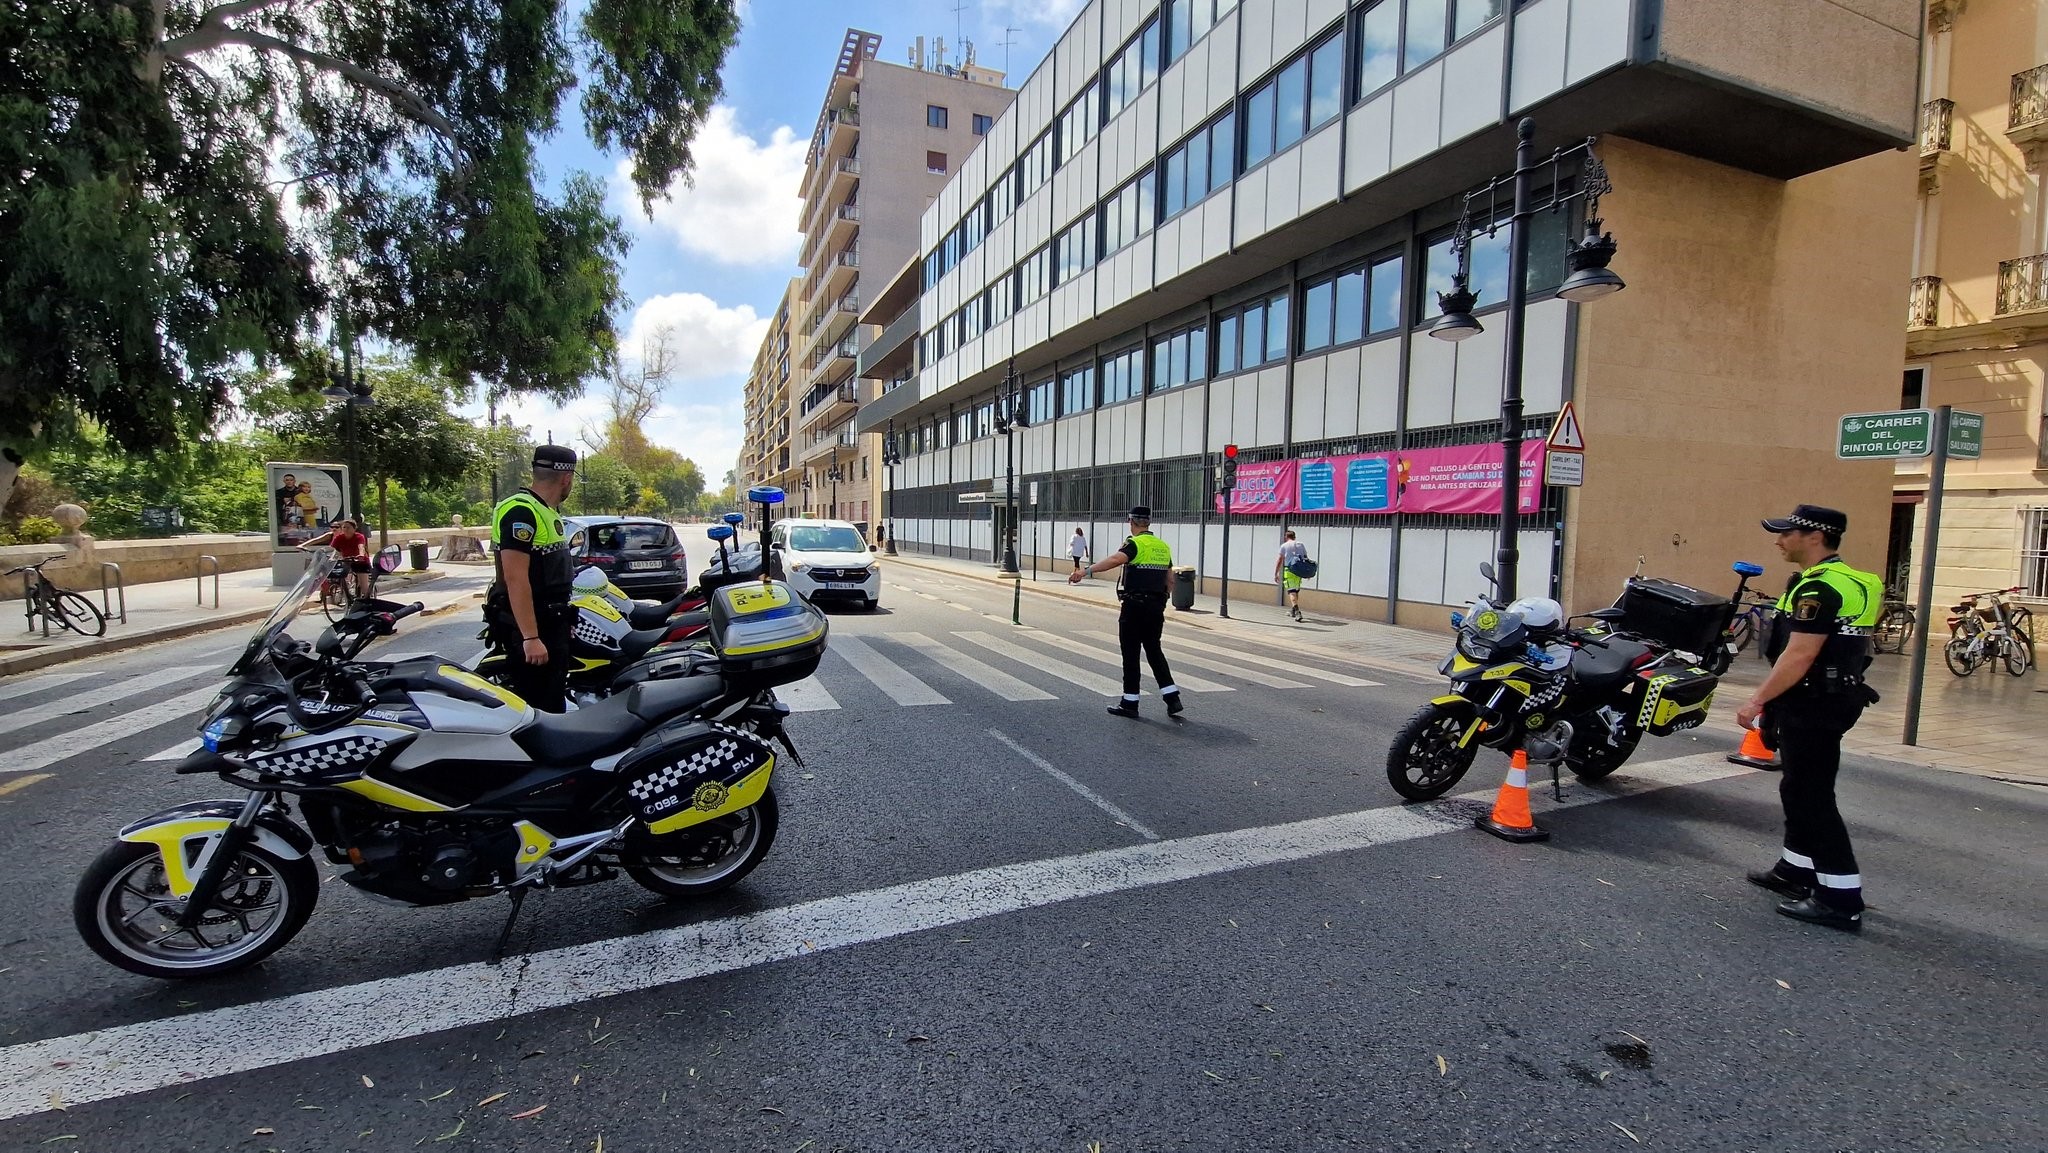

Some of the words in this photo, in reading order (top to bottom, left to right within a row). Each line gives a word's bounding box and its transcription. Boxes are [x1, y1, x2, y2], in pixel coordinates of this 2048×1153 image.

[1865, 416, 1922, 429] CARRER
[1959, 417, 1981, 428] CARRER
[1872, 431, 1894, 439] DEL
[1961, 430, 1970, 438] DEL
[1842, 442, 1883, 453] PINTOR
[1886, 438, 1924, 451] LÓPEZ
[1949, 440, 1979, 451] SALVADOR
[1429, 463, 1457, 473] INCLUSO
[1458, 463, 1467, 471] LA
[1468, 462, 1491, 471] GENTE
[1492, 462, 1503, 471] QU
[1420, 474, 1430, 482] NO
[1431, 473, 1450, 481] PUEDE
[1452, 471, 1485, 480] CAMBIAR
[1486, 470, 1497, 479] SU
[1236, 476, 1276, 491] LICITA
[1437, 482, 1458, 490] ANTES
[1468, 481, 1497, 489] CRUZAR
[1240, 490, 1277, 504] PLAZA
[735, 593, 748, 606] PLV
[591, 600, 615, 616] PLV
[364, 709, 399, 722] ALENCIA
[732, 753, 755, 773] PLV
[654, 795, 679, 811] 092
